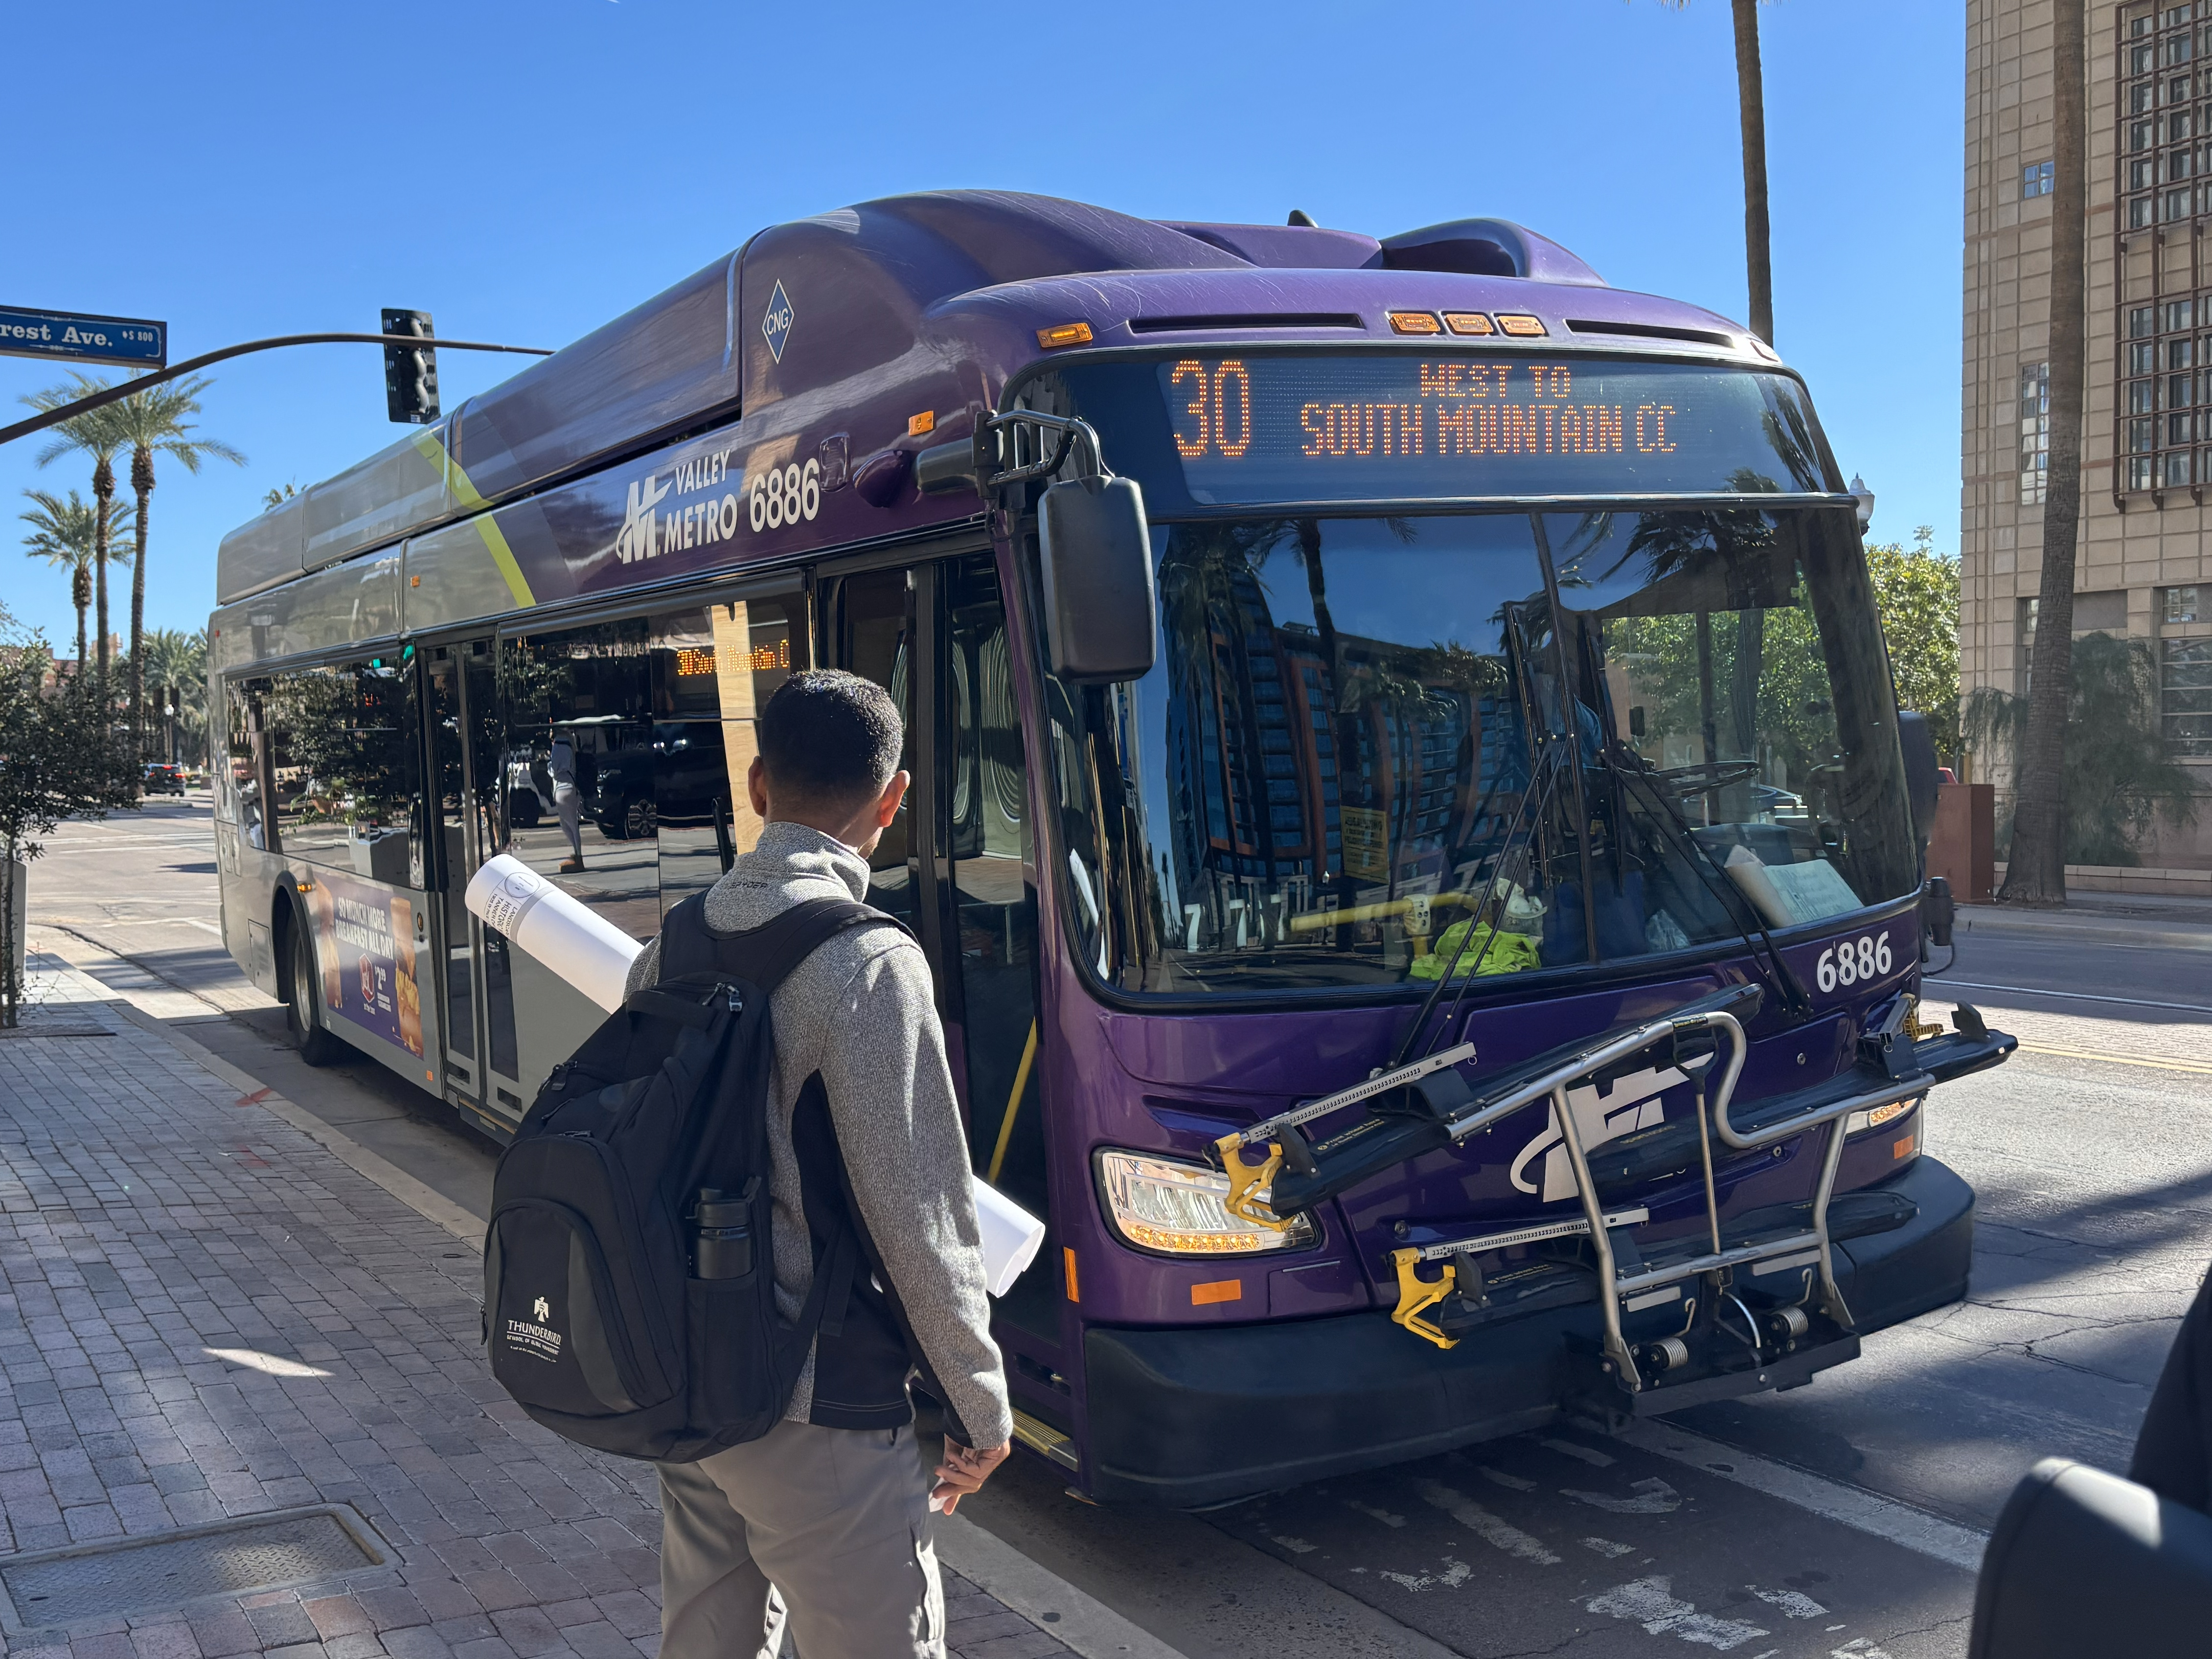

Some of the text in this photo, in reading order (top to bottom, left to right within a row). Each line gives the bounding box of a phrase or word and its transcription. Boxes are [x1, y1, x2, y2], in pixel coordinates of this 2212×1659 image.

[62, 326, 113, 346] Ave.
[137, 331, 153, 342] 800
[767, 308, 789, 335] CNG
[1421, 364, 1571, 398] WEST TO
[1172, 360, 1250, 456] 30
[1301, 404, 1677, 455] SOUTH MOUNTAIN CC
[675, 449, 731, 495] VALLEY
[750, 458, 820, 533] 6886
[664, 494, 737, 554] METRO
[335, 919, 393, 960] BREAKFAST ALL DAY
[1817, 931, 1892, 993] 6886
[508, 1319, 561, 1345] THUNDERBIRD
